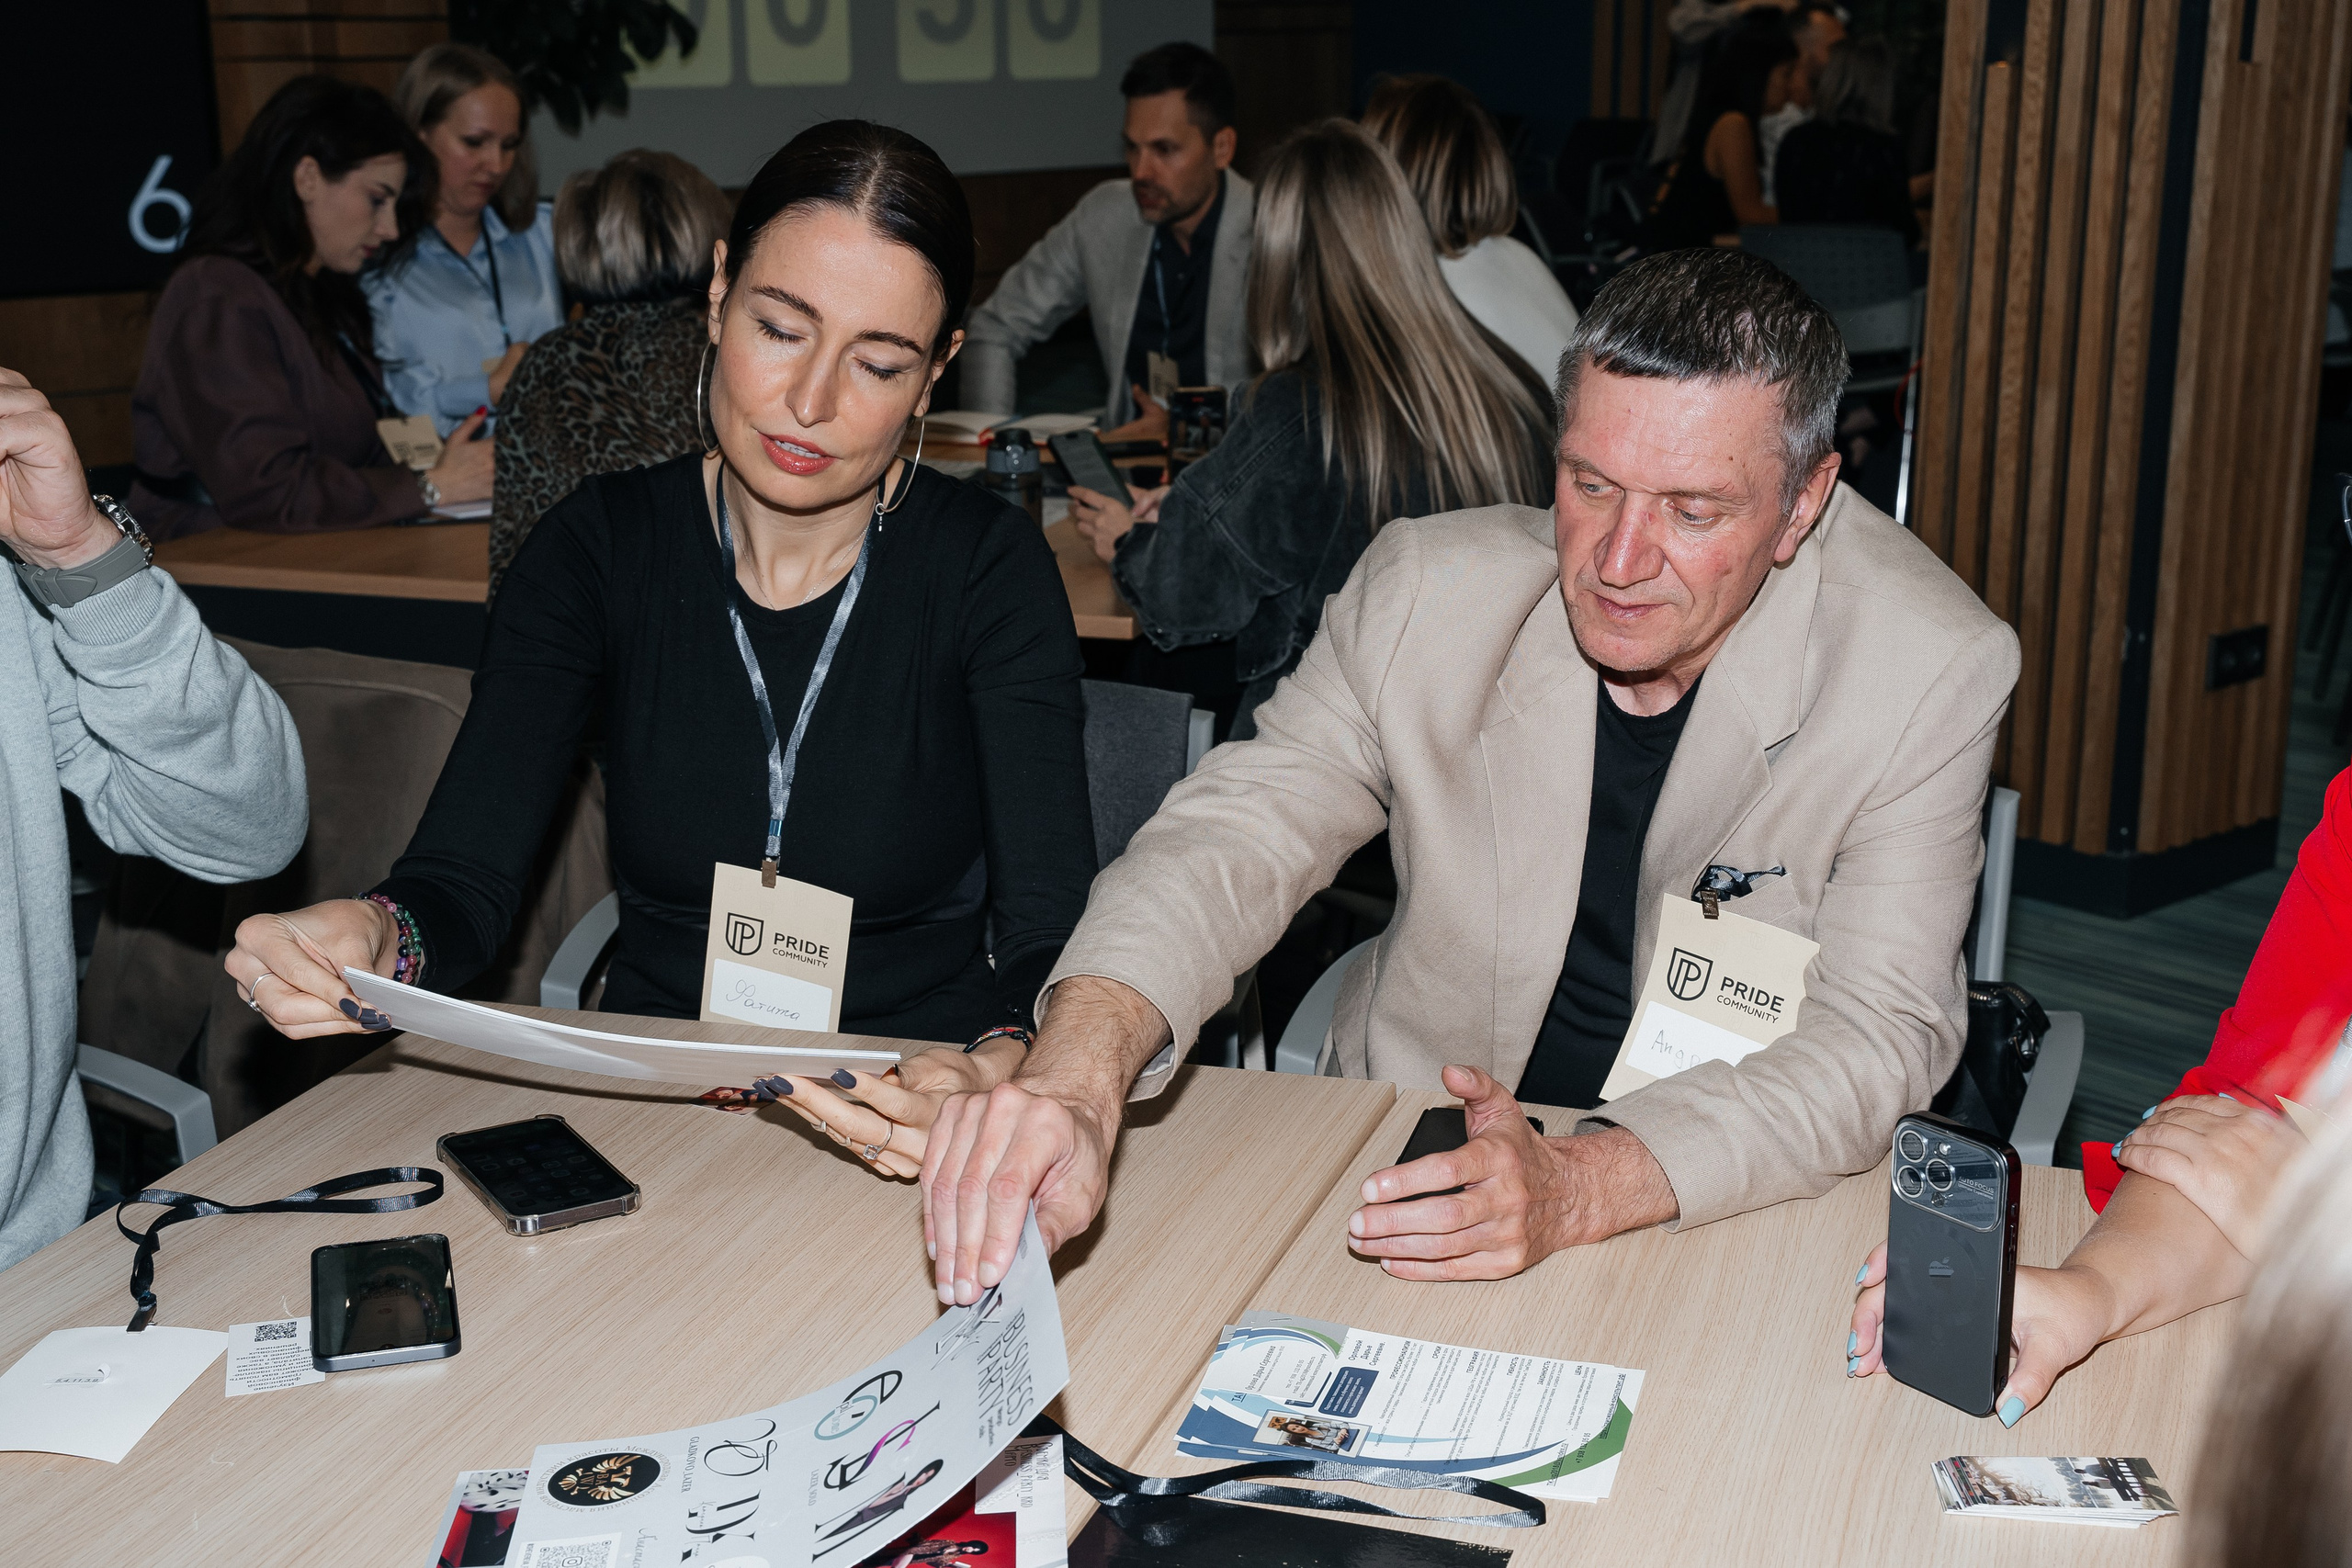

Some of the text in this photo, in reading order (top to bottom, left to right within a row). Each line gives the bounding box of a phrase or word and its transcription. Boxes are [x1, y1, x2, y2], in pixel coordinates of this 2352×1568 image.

[128, 154, 191, 253] 6
[774, 932, 830, 959] PRIDE
[772, 947, 828, 968] COMMUNITY
[1720, 976, 1784, 1013] PRIDE
[1716, 995, 1779, 1024] COMMUNITY
[1958, 1177, 1995, 1194] AUTO FOCUS
[248, 1346, 301, 1354] финансовых
[1347, 1338, 1363, 1361] Орловой
[1359, 1344, 1374, 1359] Дарье
[1368, 1340, 1386, 1366] Сергеевне.
[1389, 1339, 1411, 1380] ПРОФЕССИОНАЛИЗМ
[1431, 1345, 1442, 1359] СРОКИ
[237, 1363, 286, 1371] умножения
[1003, 1309, 1034, 1427] BUSINESS
[1465, 1350, 1480, 1373] ГЕОГРАФИЯ
[1506, 1356, 1519, 1376] ГИБКОСТЬ
[1536, 1359, 1551, 1385] ЗАКОННОСТЬ
[1574, 1364, 1583, 1375] ЦЕНА
[246, 1372, 301, 1383] грамотности
[247, 1376, 300, 1387] финансовой
[253, 1382, 294, 1391] Изучение
[978, 1337, 1004, 1420] PARTY
[567, 1447, 619, 1462] красоты
[681, 1436, 700, 1494] GLADKOVO_LAZER
